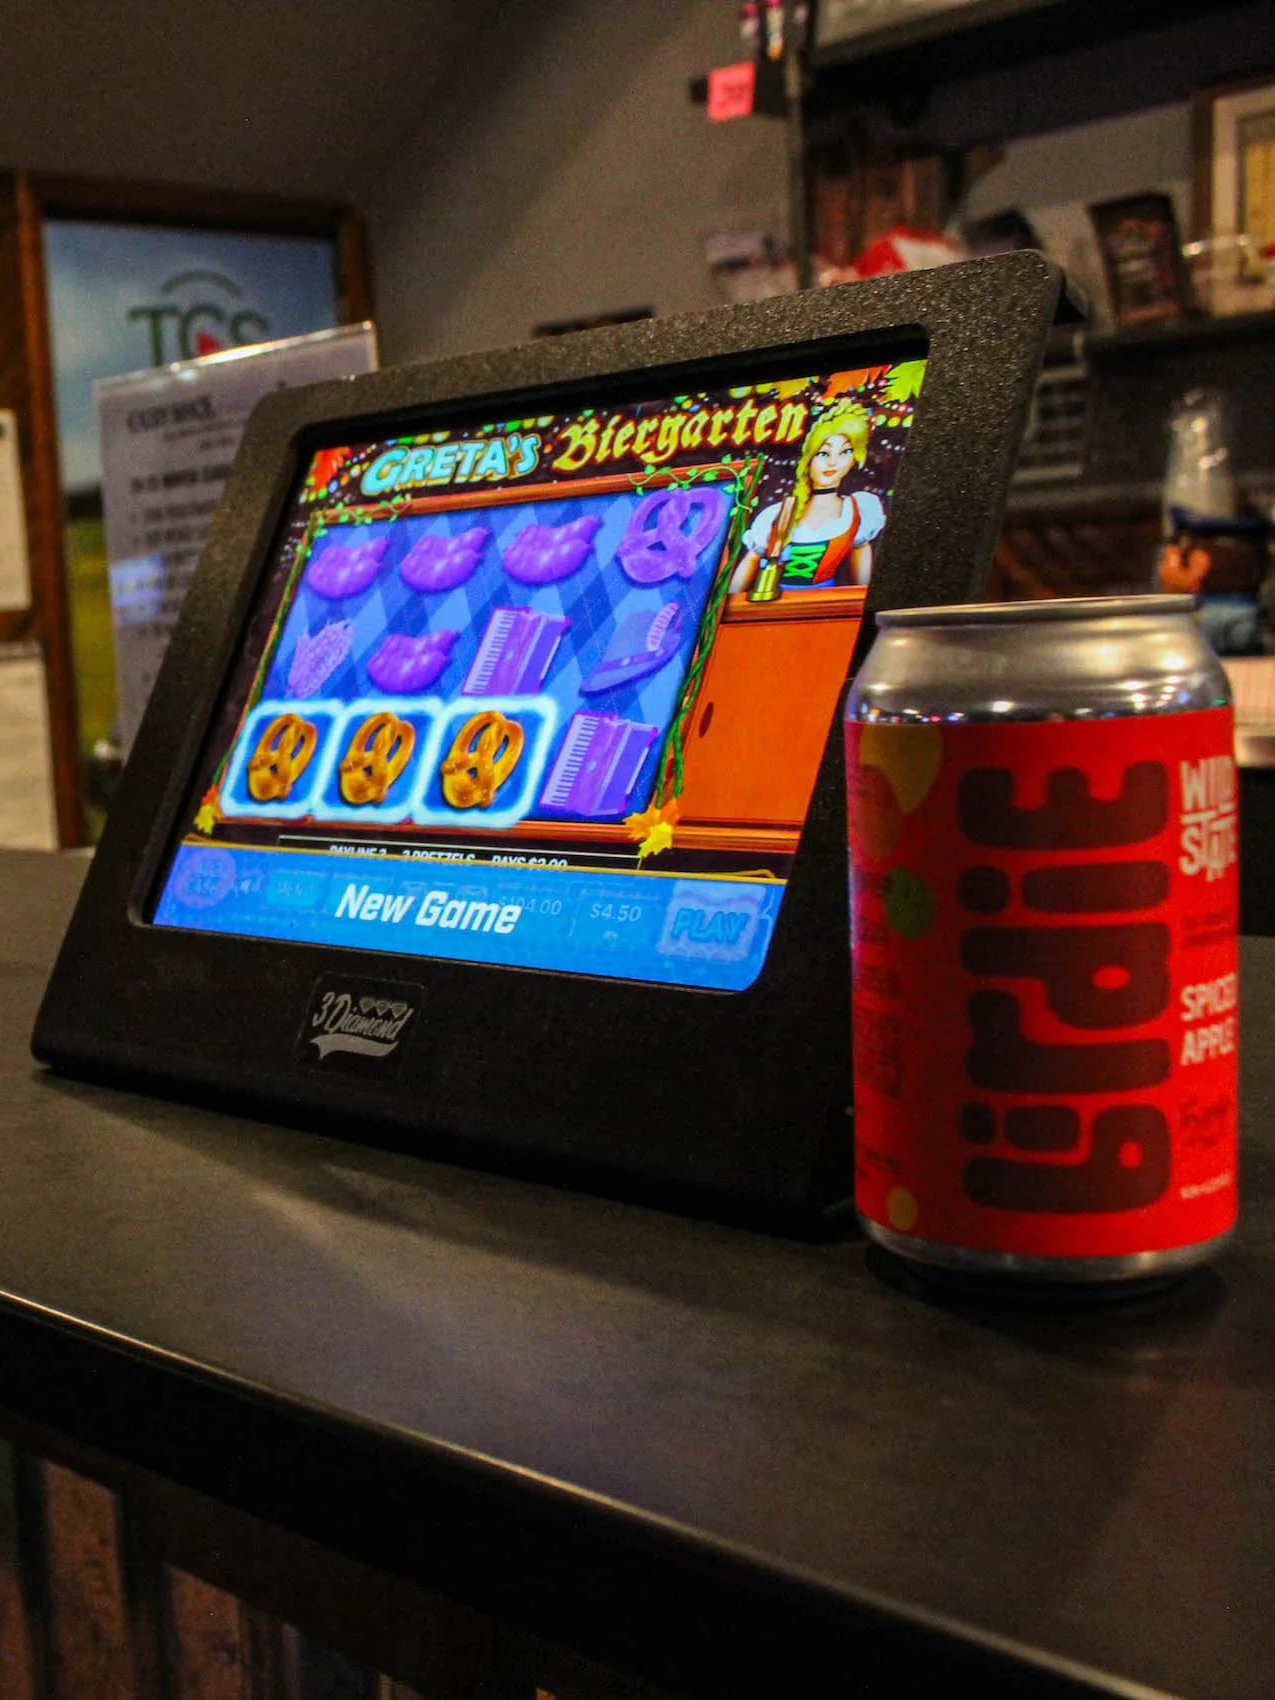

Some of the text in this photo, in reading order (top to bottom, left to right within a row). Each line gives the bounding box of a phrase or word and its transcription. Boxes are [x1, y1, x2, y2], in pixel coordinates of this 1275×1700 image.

[361, 398, 809, 495] GRETA'S Biergarten
[334, 882, 415, 925] New
[415, 890, 523, 934] Game
[671, 906, 750, 945] PLAY
